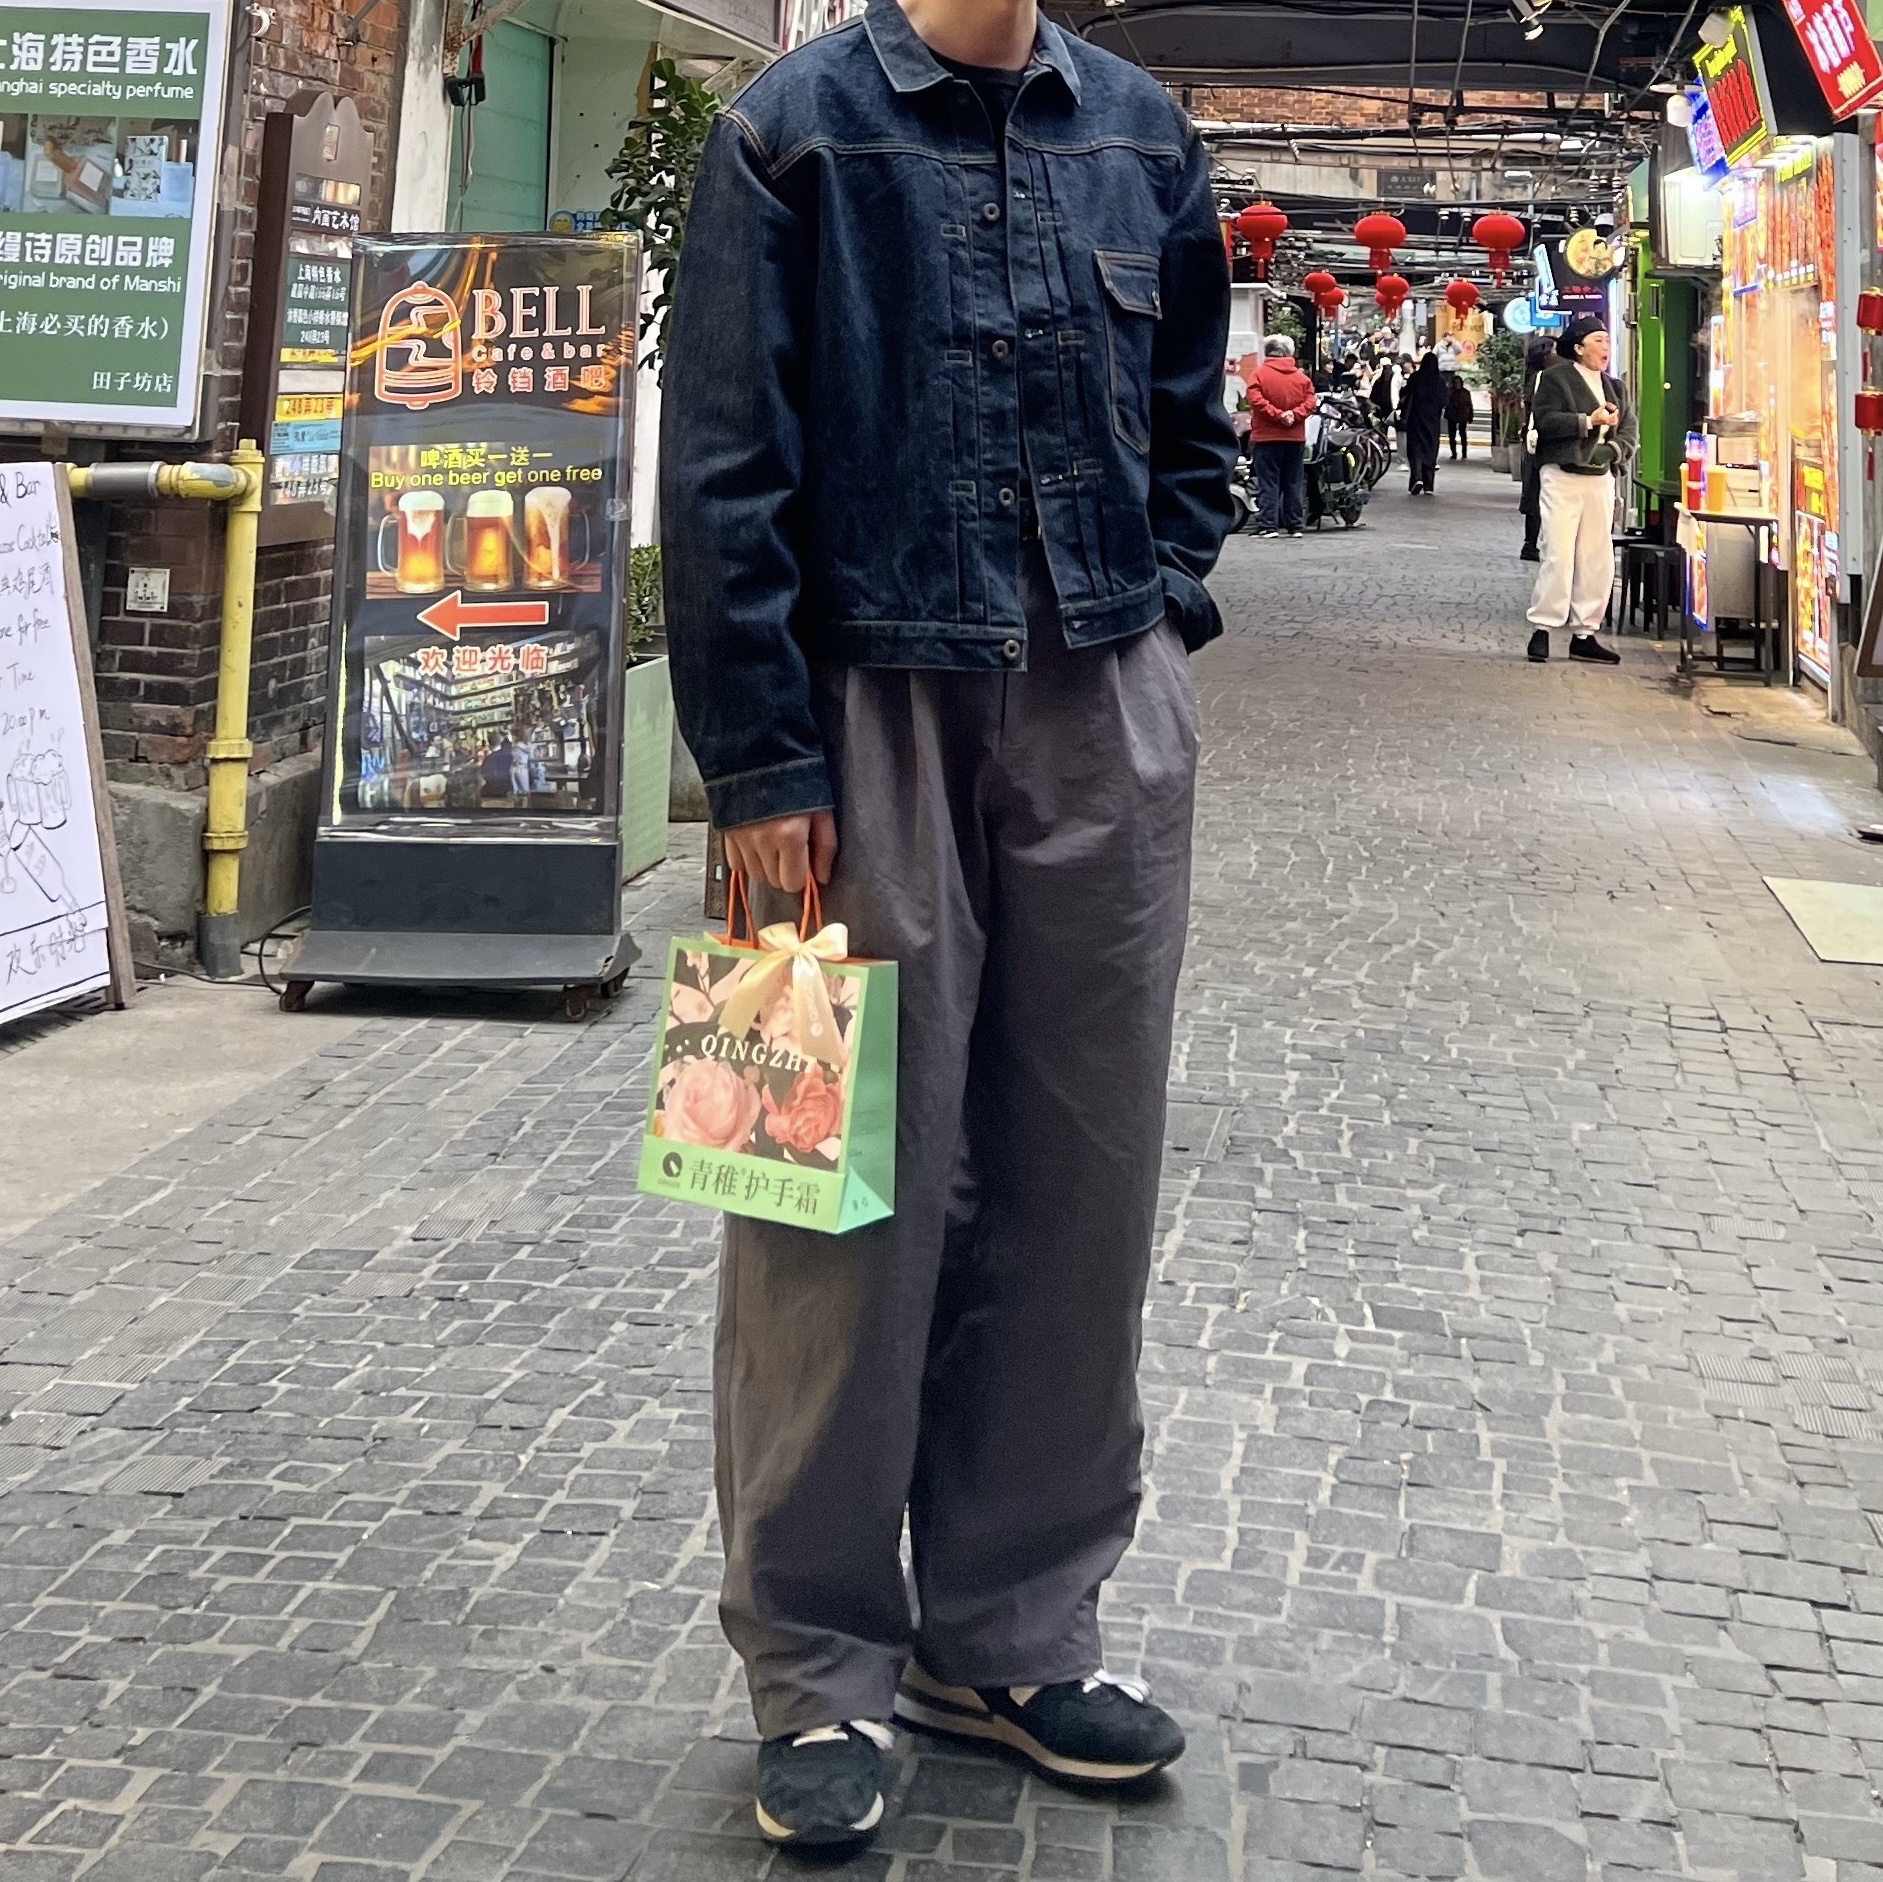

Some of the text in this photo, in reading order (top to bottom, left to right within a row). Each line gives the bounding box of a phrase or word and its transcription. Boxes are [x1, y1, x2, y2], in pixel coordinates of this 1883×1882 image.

[0, 32, 199, 76] 海特色香水
[0, 78, 194, 100] nghai specialty perfume
[50, 272, 96, 290] brand
[100, 275, 120, 290] of
[124, 275, 182, 293] Manshi
[471, 284, 606, 340] BELL
[92, 371, 174, 393] 田子坊店
[472, 365, 606, 395] 铃铛酒吧
[420, 446, 553, 470] 啤酒买一送一
[16, 471, 41, 499] Bar
[371, 465, 603, 490] Buy one beer get one free
[417, 643, 549, 676] 欢迎光临
